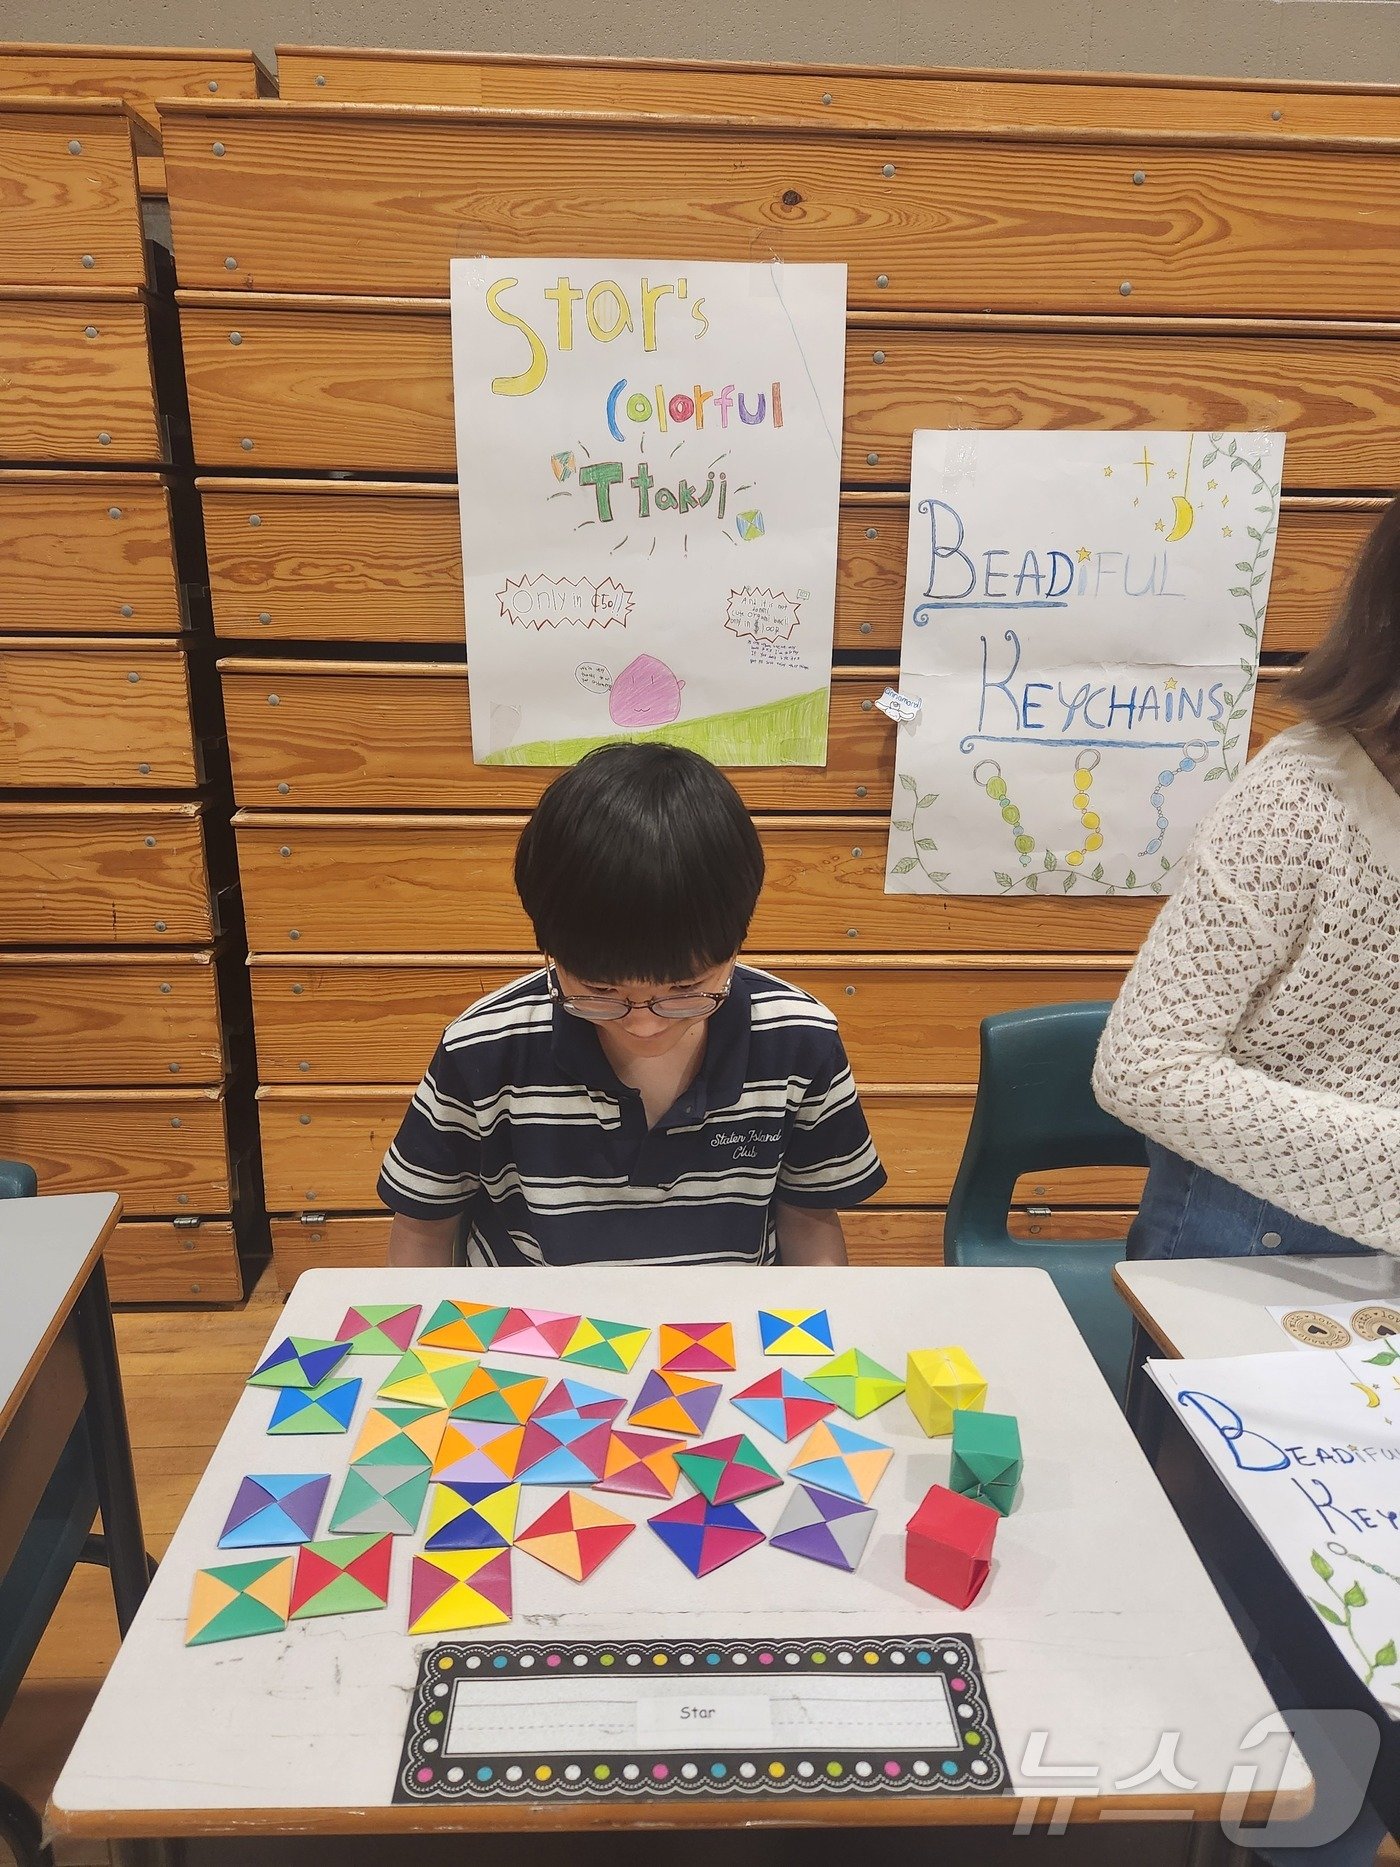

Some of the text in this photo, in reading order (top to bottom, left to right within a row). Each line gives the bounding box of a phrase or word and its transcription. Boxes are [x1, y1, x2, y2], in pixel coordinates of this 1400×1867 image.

[486, 277, 709, 397] Star's
[606, 379, 784, 442] Colorful
[579, 461, 728, 523] Ttakji
[512, 589, 566, 613] Only
[572, 592, 582, 608] in
[710, 1129, 782, 1147] Staten Island
[732, 1145, 758, 1160] Club
[680, 1706, 716, 1720] Star
